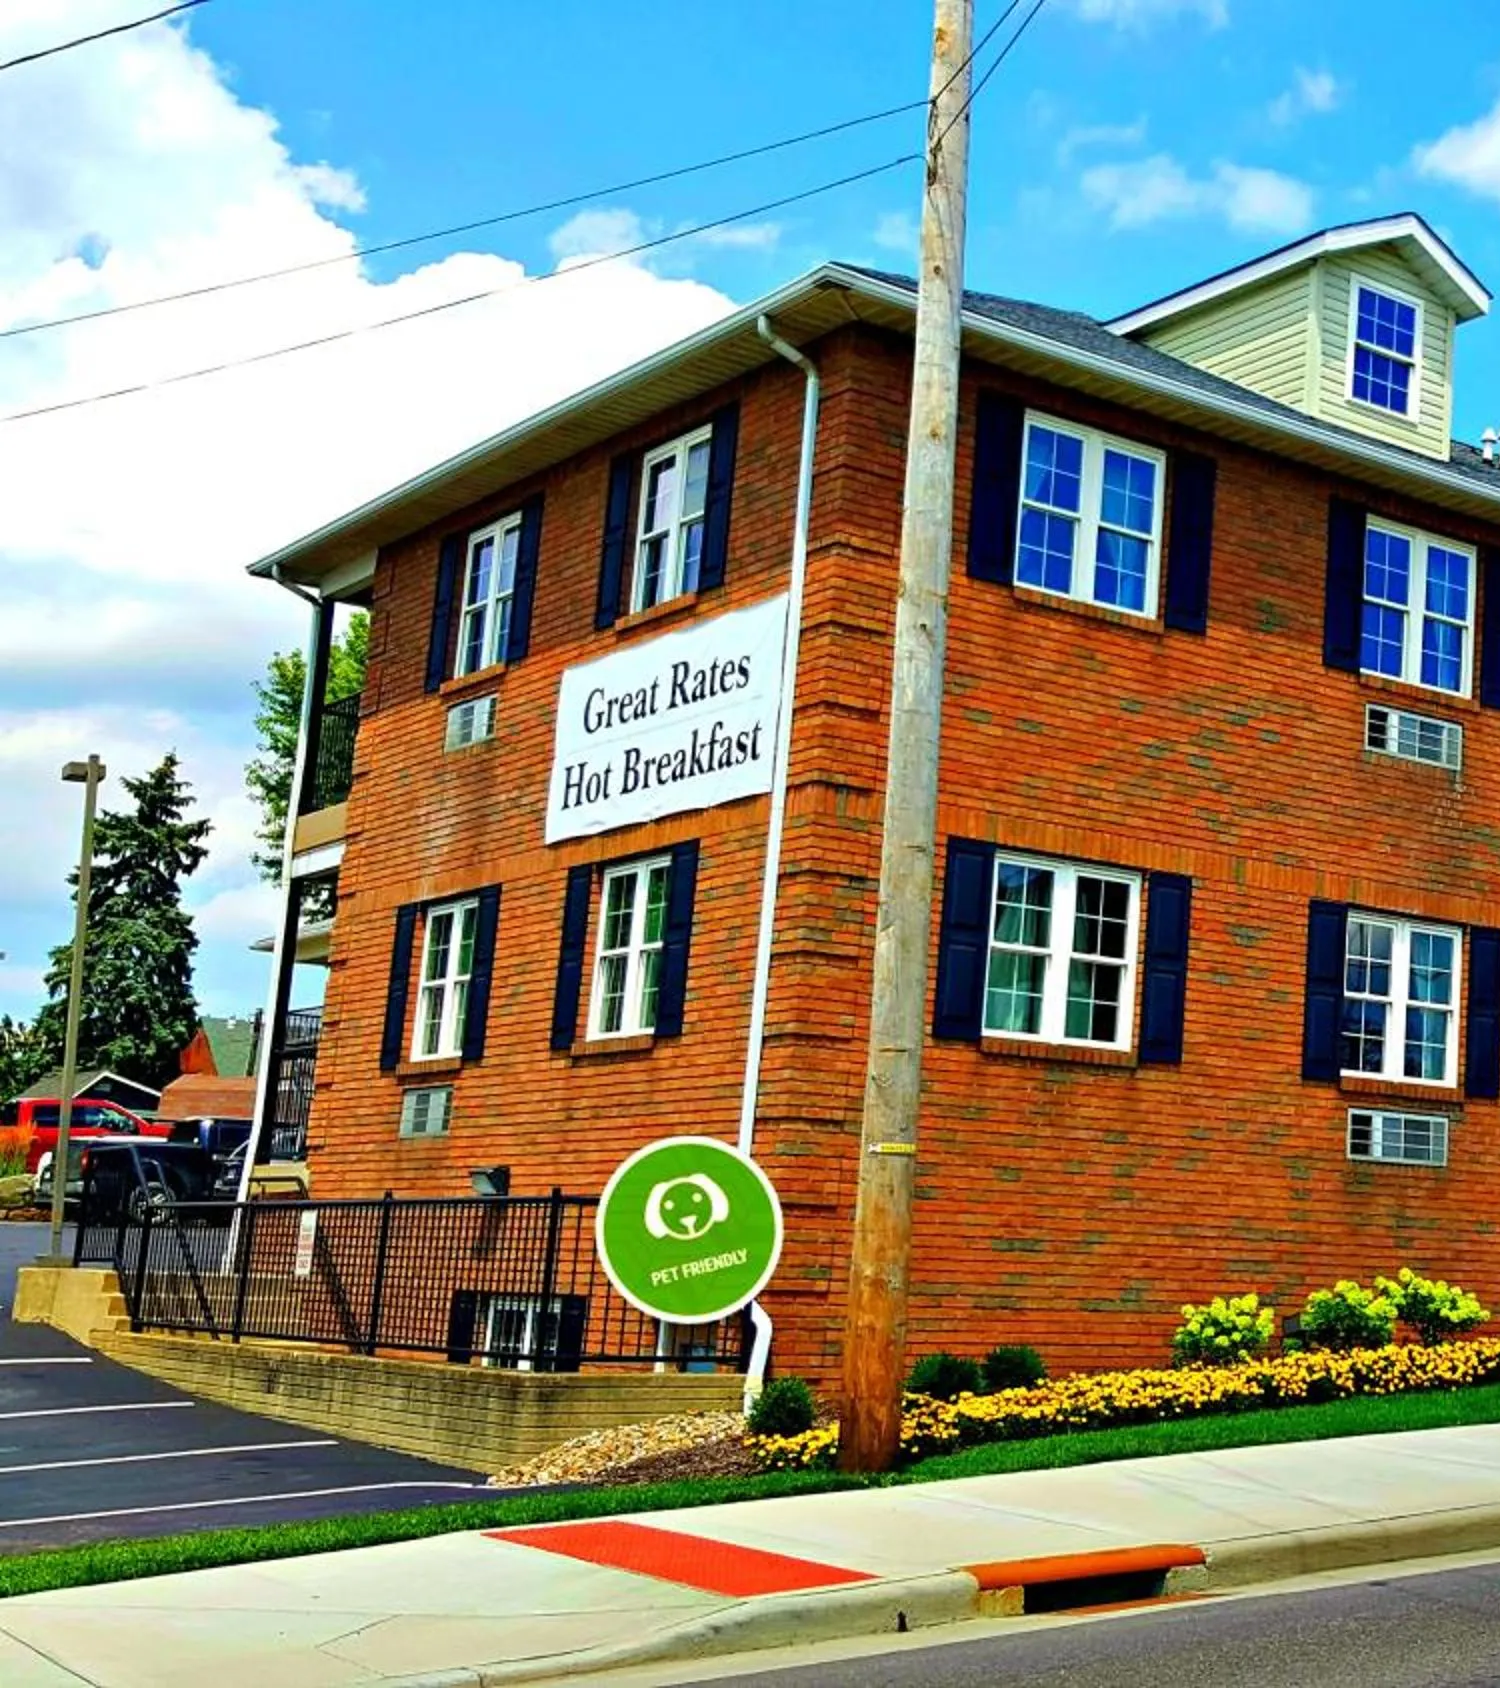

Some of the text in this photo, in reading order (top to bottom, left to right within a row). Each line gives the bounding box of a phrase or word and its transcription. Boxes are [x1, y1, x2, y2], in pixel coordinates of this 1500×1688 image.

[583, 655, 751, 734] Great Rates
[561, 720, 763, 811] Hot Breakfast
[651, 1247, 748, 1287] PET FRIENDLY
